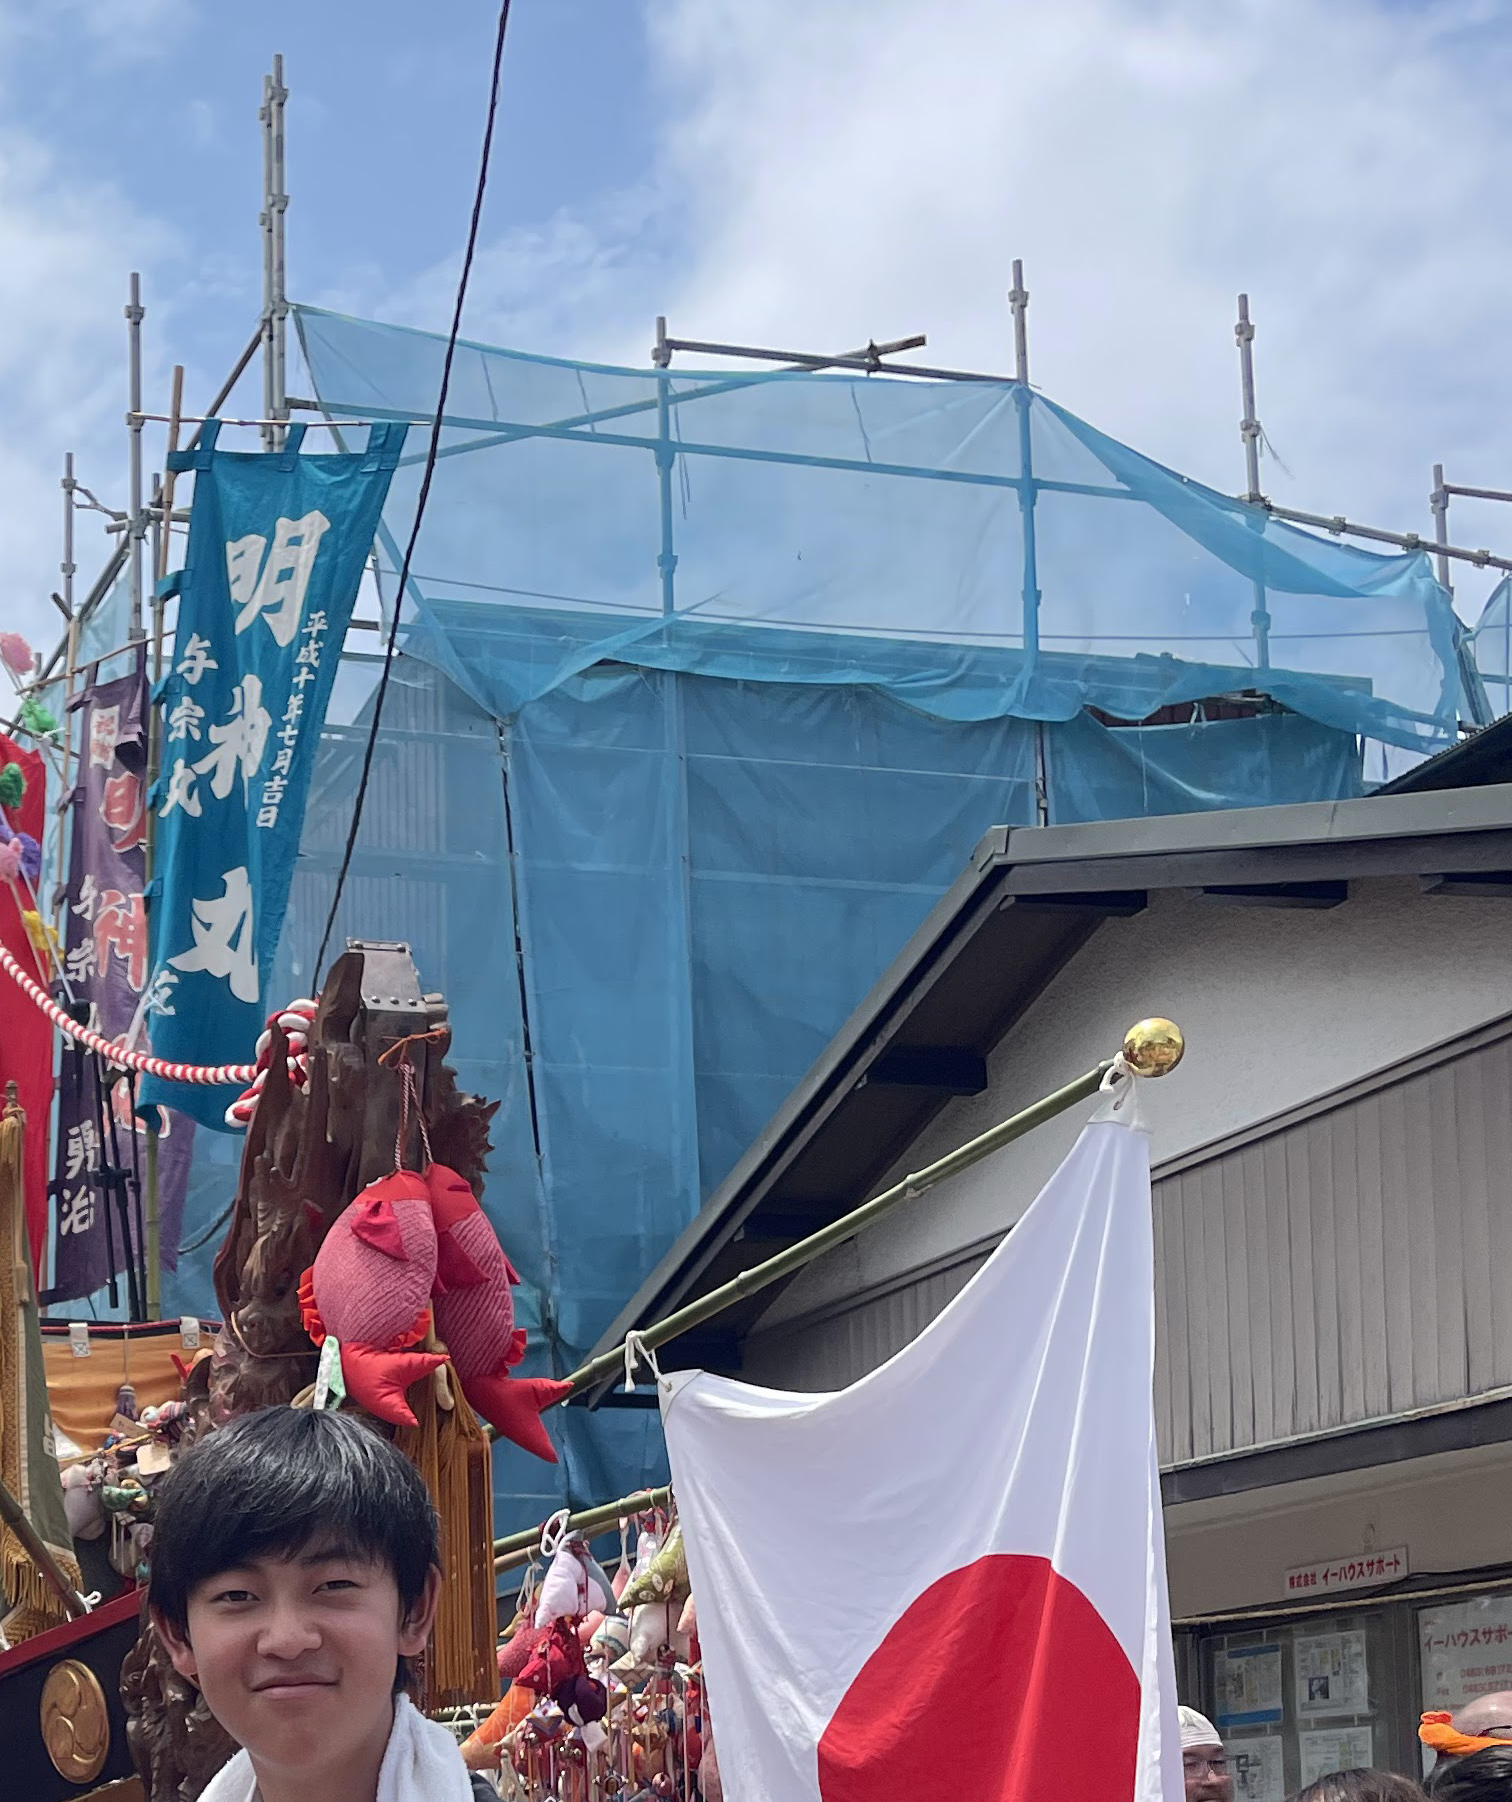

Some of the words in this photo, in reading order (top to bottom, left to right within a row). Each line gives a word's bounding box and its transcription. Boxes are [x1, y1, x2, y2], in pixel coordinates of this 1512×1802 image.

[158, 633, 219, 818] 与宗丸
[166, 510, 330, 1004] 明神丸
[256, 610, 328, 828] 平成十年七月吉日
[1289, 1571, 1316, 1589] 株式会社
[1322, 1553, 1401, 1586] イーハウスサポート
